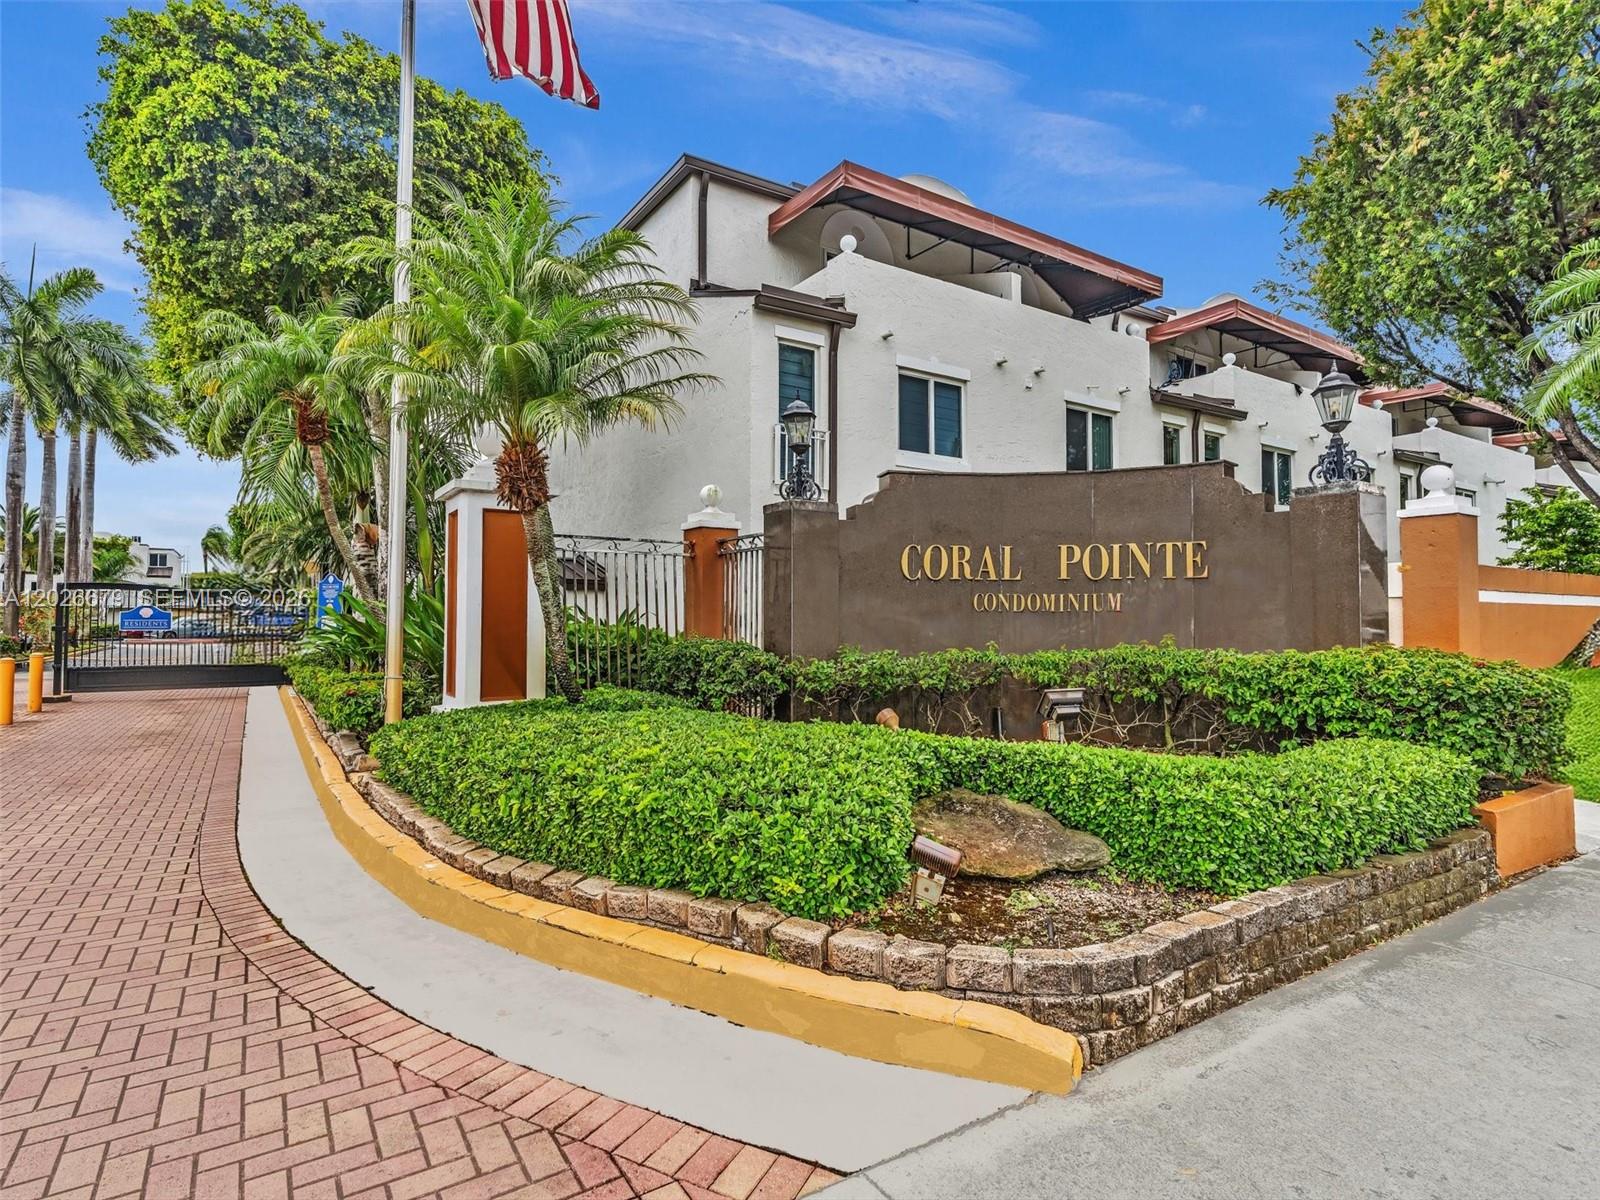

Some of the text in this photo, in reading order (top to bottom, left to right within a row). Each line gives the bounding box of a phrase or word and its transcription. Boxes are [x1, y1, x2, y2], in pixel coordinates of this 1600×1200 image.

[901, 540, 1209, 581] CORAL POINTE
[973, 592, 1123, 613] CONDOMINIUM
